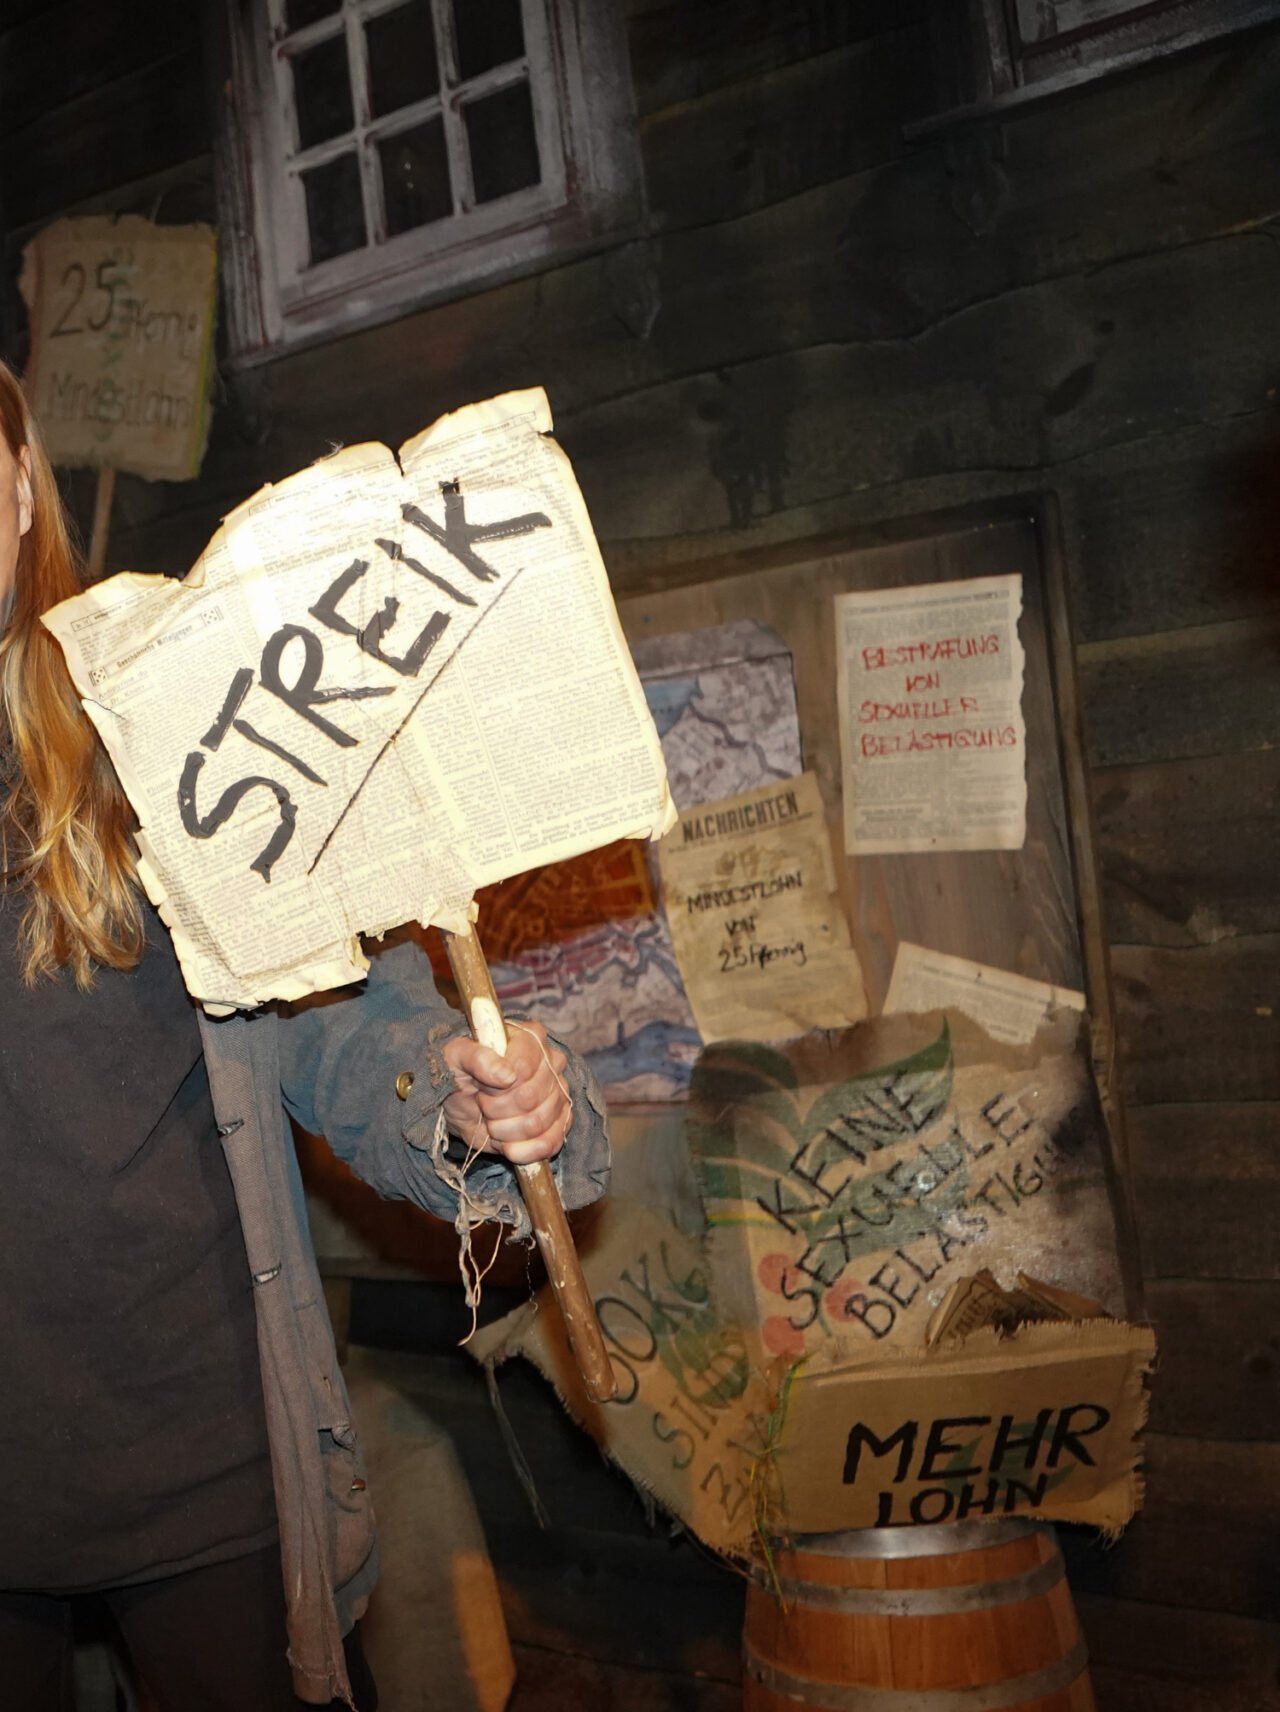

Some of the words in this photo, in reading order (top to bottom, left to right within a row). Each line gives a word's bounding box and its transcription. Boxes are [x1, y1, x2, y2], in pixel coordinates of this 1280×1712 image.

[49, 260, 117, 338] 25
[862, 634, 1000, 670] BESTRAFUNG
[177, 477, 552, 884] STREIK
[906, 671, 940, 692] VON
[858, 696, 979, 723] SEXUELLER
[682, 792, 799, 843] NACHRICHTEN
[687, 870, 803, 914] MINDESTLOHN
[756, 1069, 940, 1234] KEINE
[780, 1092, 1034, 1330] SEXUELLE
[843, 1403, 1110, 1484] MEHR
[874, 1474, 1048, 1528] LOHN
